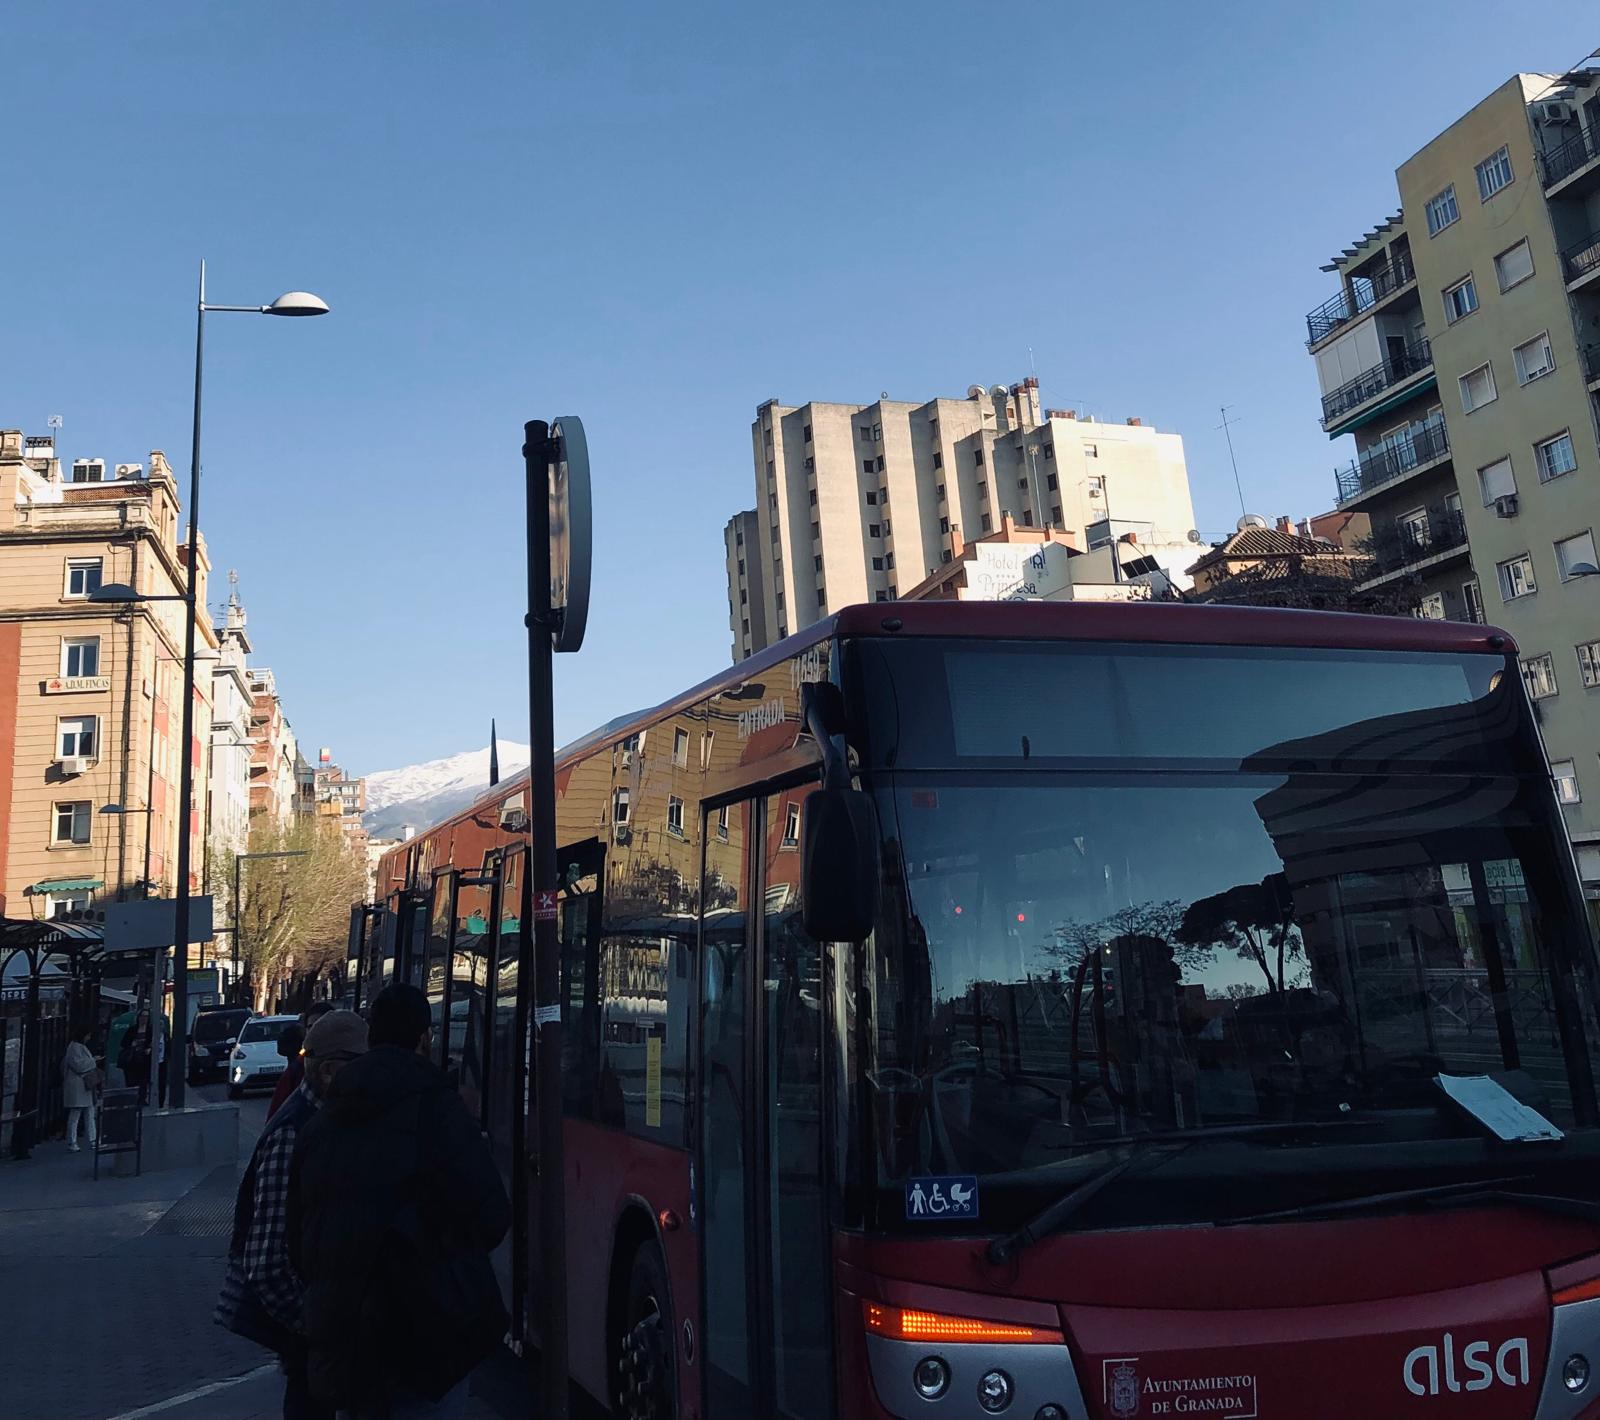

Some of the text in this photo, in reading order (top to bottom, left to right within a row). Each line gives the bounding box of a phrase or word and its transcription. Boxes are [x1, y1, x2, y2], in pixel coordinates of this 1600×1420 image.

[985, 552, 1018, 570] Hotel
[978, 573, 1037, 594] Princesa
[85, 678, 109, 688] FINCAS
[738, 696, 785, 739] ENTRADA
[1403, 1332, 1529, 1396] alsa
[1142, 1375, 1251, 1394] AYUNTAMIENTO
[1152, 1395, 1243, 1414] DE GRANADA
